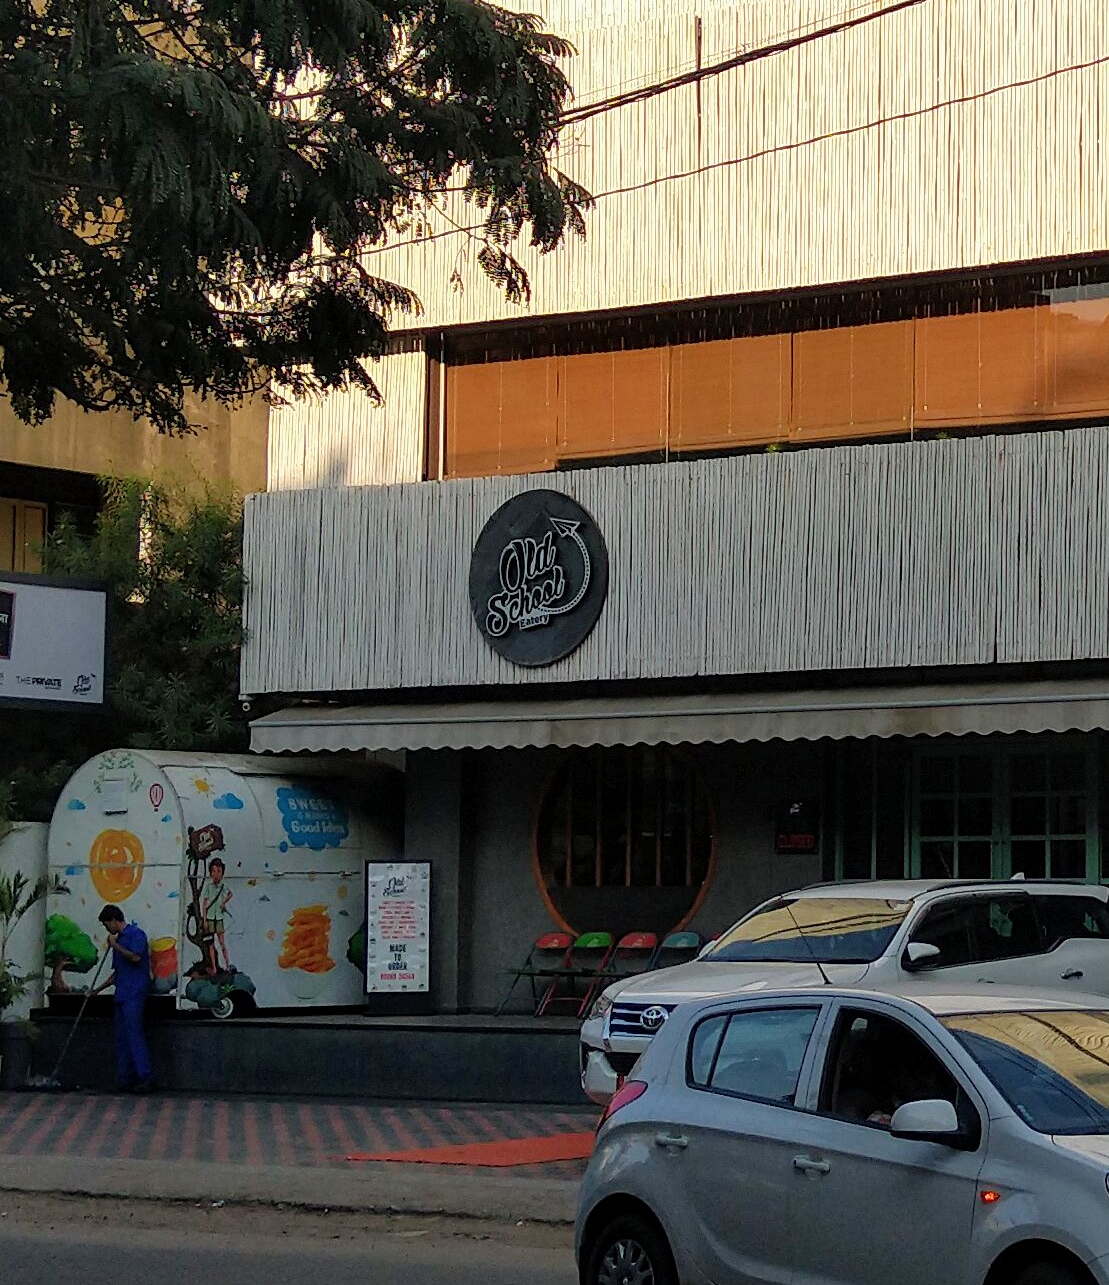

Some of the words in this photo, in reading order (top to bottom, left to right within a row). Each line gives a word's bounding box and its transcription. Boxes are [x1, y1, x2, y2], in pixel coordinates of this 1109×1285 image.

[499, 531, 556, 592] Old
[486, 565, 565, 637] School
[520, 613, 549, 628] Eatery
[32, 677, 63, 688] PRIVATE
[291, 820, 320, 833] Good
[394, 953, 402, 961] TO
